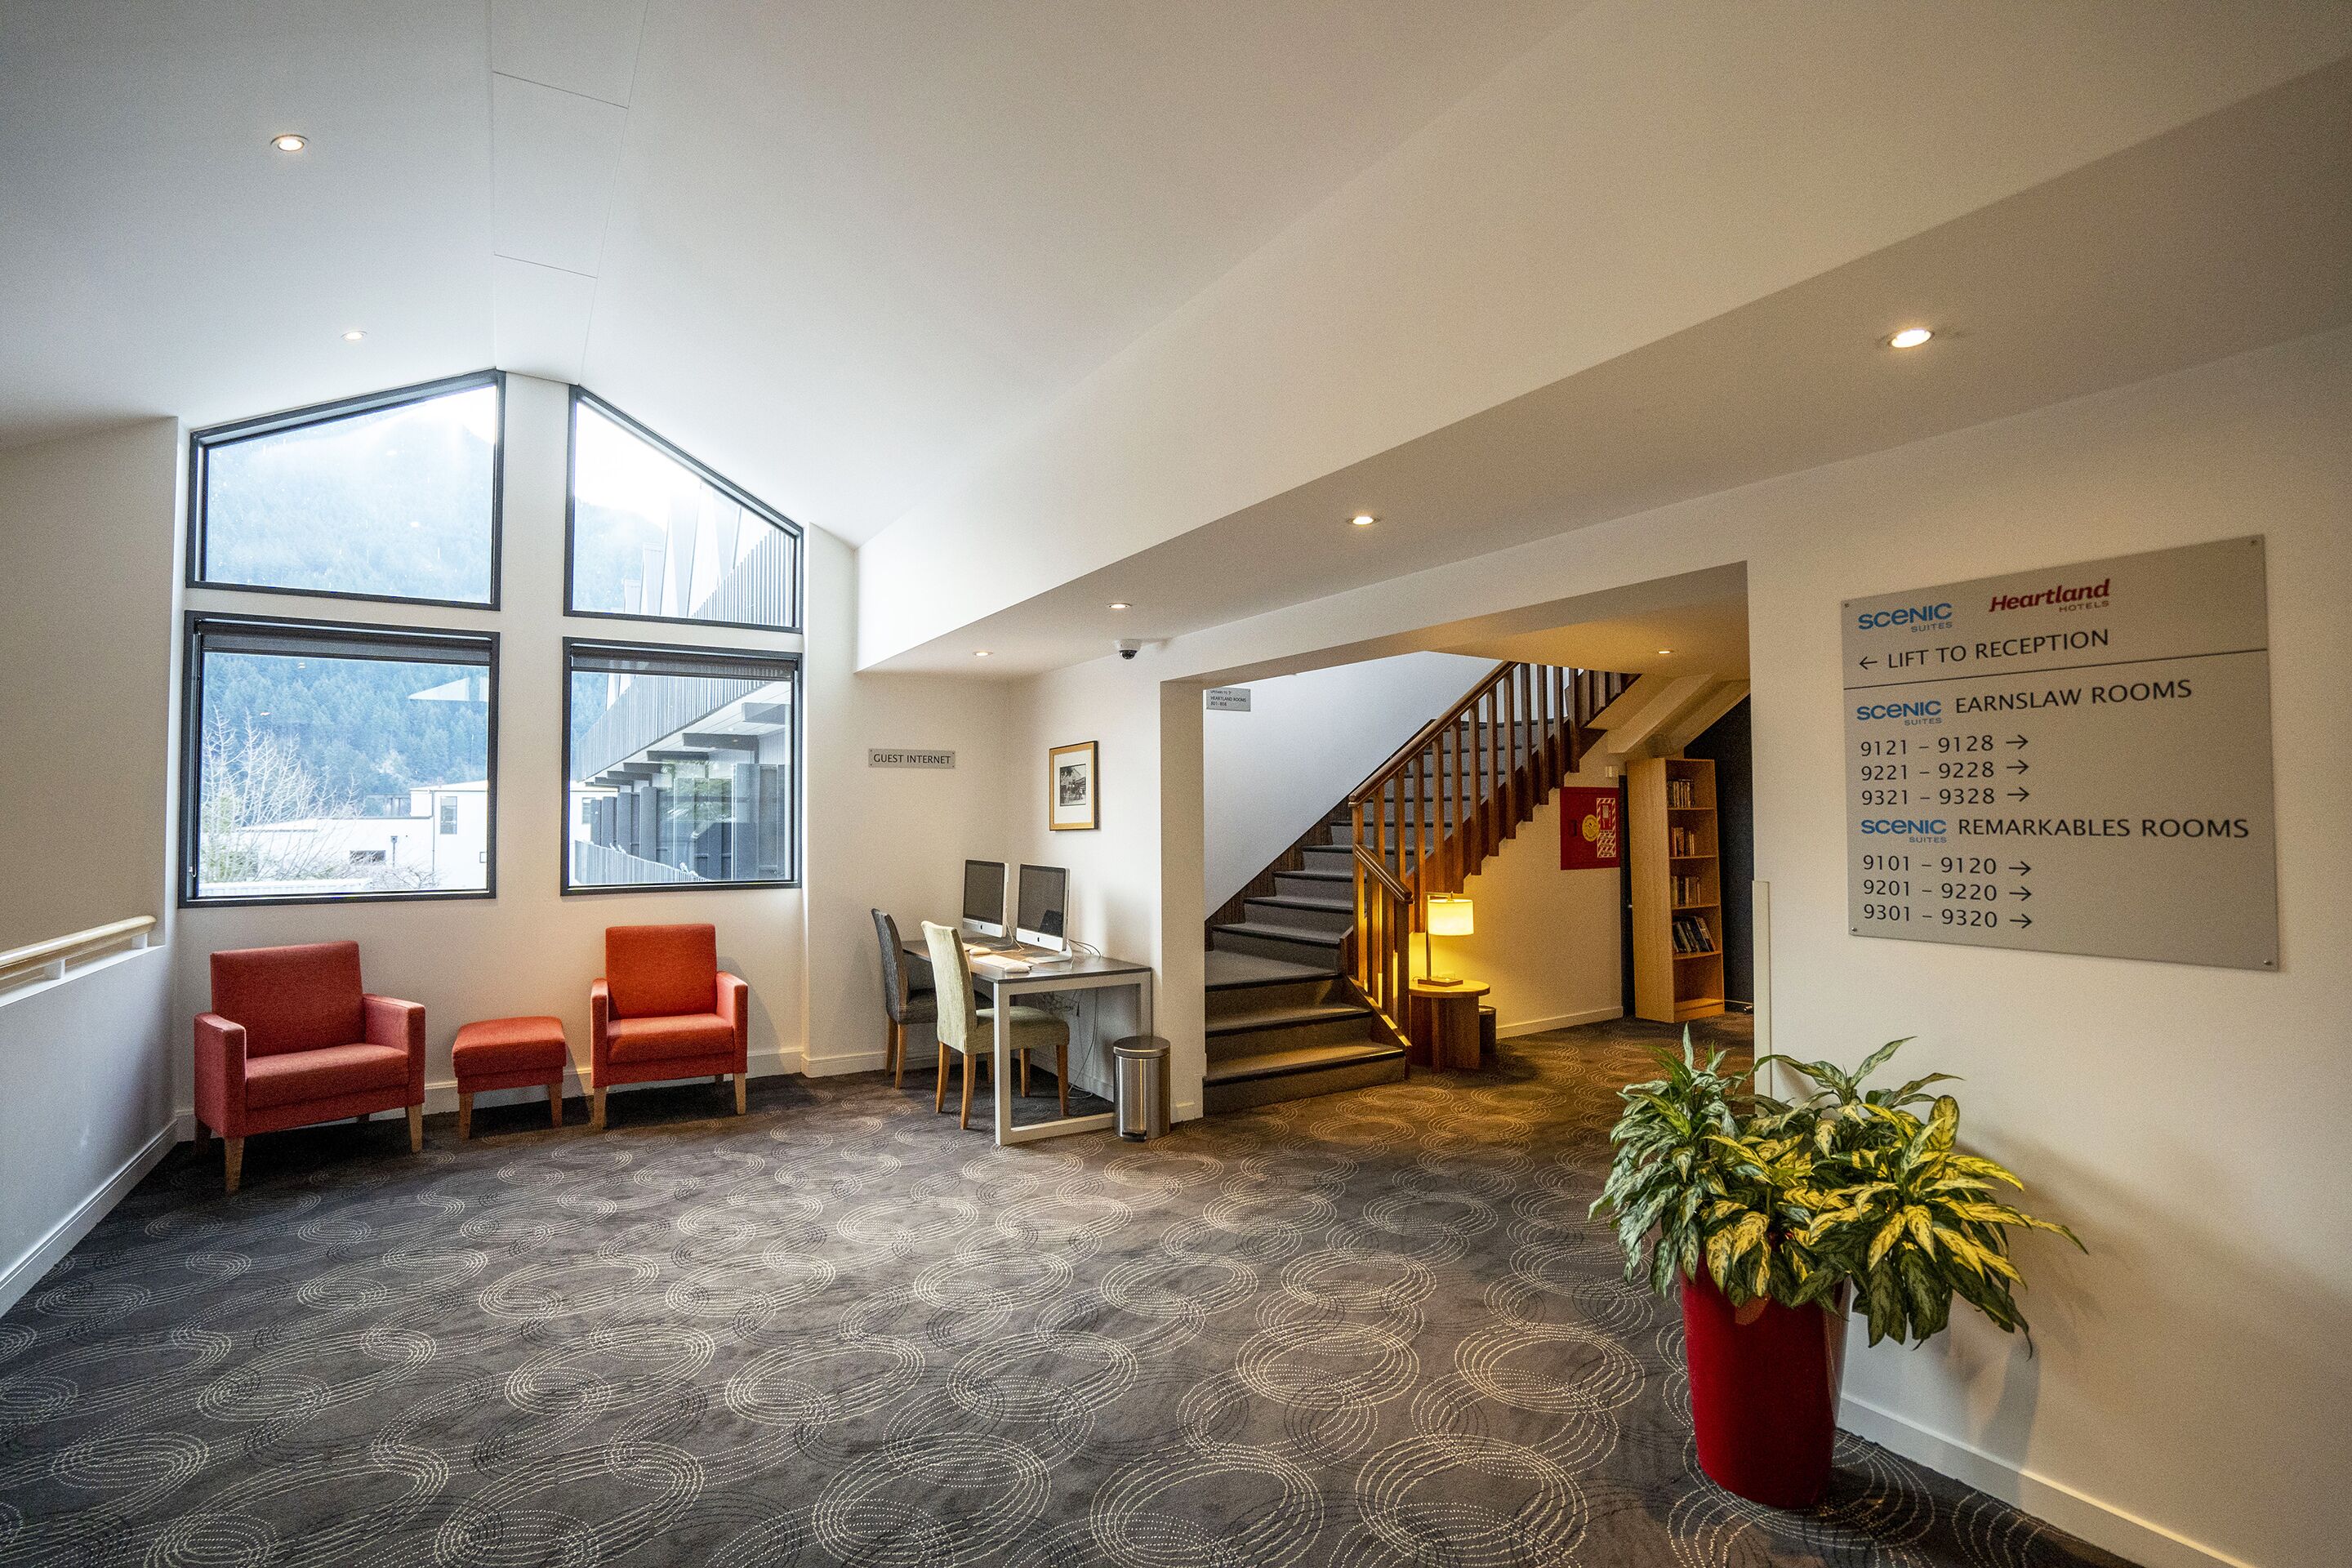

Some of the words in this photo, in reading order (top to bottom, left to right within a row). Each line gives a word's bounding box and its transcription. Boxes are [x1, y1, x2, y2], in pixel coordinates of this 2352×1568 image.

[1989, 578, 2110, 612] Heartland
[2059, 600, 2109, 612] HOTELS
[1911, 621, 1953, 633] SUITES
[1888, 650, 1929, 669] LIFT
[1936, 645, 1967, 663] TO
[1976, 629, 2109, 659] RECEPTION
[1956, 688, 2082, 714] EARNSLAW
[2091, 679, 2192, 704] ROOMS
[1904, 717, 1943, 726] SUITES
[1860, 740, 1906, 756] 9121
[1938, 735, 1993, 753] 9128
[873, 754, 904, 763] GUEST
[906, 755, 951, 764] INTERNET
[1861, 764, 1907, 781] 9221
[1939, 761, 1994, 778] 9228
[1861, 790, 1907, 805] 9321
[1939, 788, 1994, 804] 9328
[1959, 819, 2130, 837] REMARKABLES
[2141, 819, 2249, 839] ROOMS
[1863, 855, 1909, 871] 9101
[1940, 857, 1997, 875] 9120
[1864, 880, 1909, 897] 9201
[1941, 883, 1997, 901] 9220
[1864, 904, 1909, 921] 9301
[1941, 909, 1998, 928] 9320
